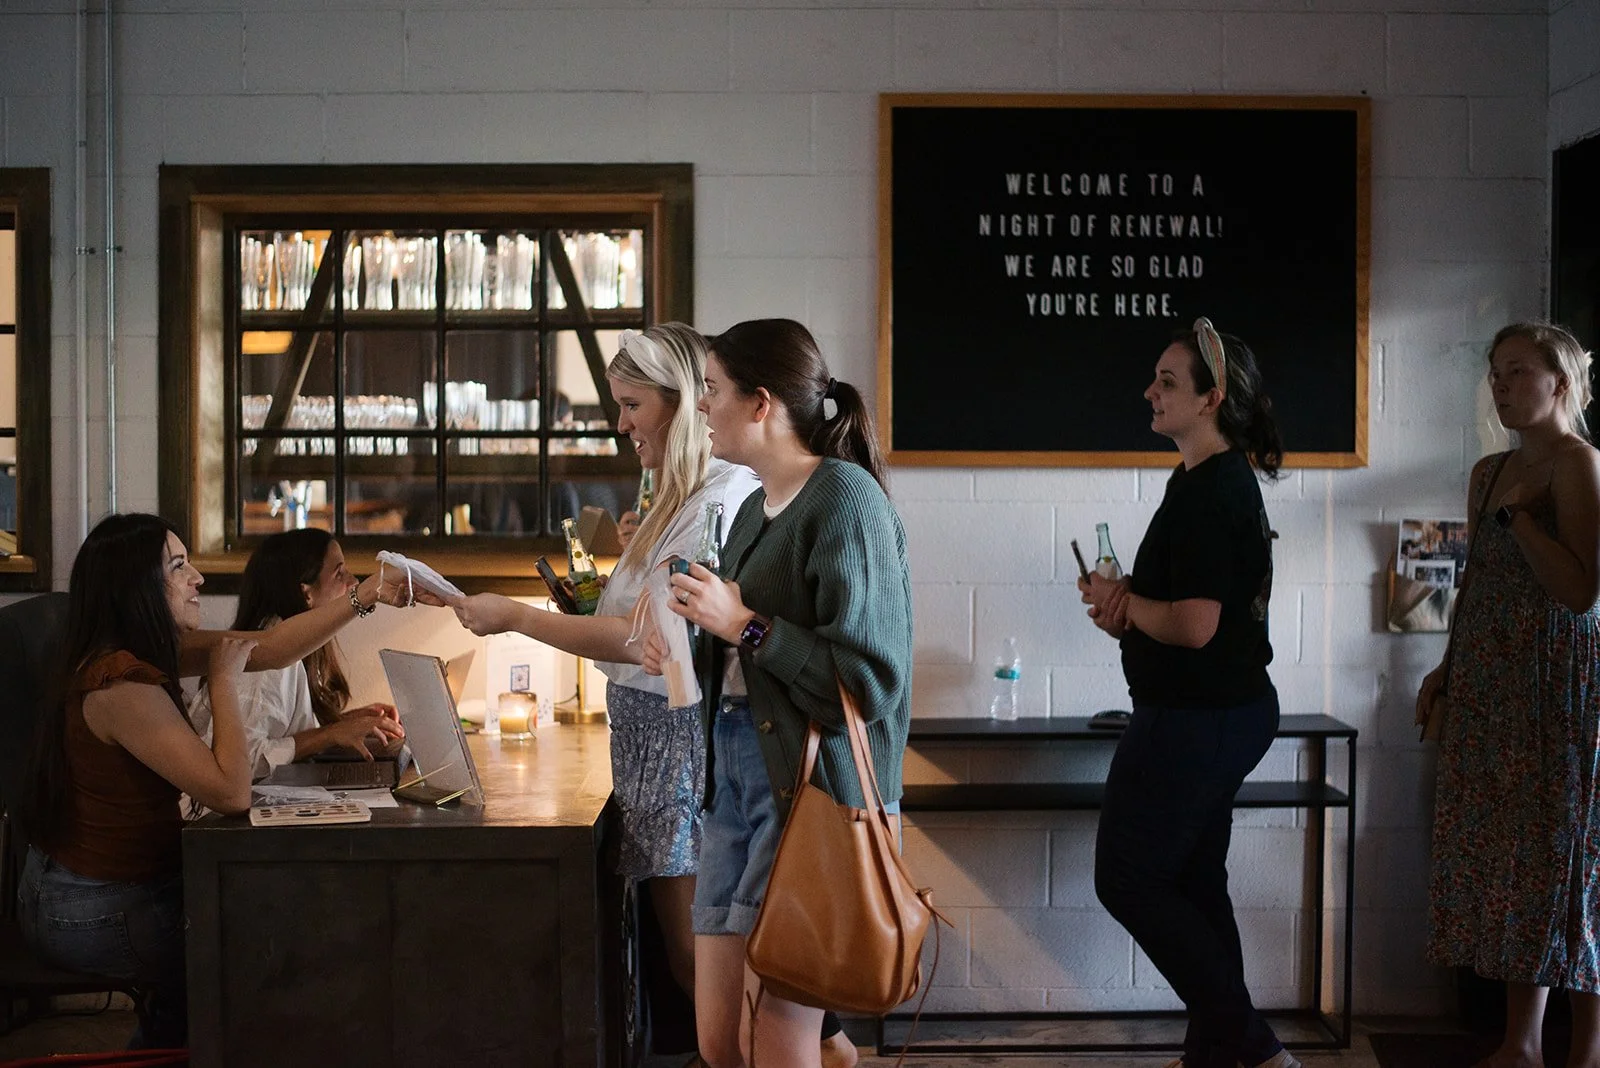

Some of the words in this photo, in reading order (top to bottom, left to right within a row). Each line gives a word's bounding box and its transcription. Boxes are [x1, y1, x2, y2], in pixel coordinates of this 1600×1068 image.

[1006, 173, 1128, 196] WELCOME
[1149, 174, 1173, 196] TO
[1192, 174, 1204, 196] A
[979, 214, 1056, 236] NIGHT
[1070, 214, 1097, 236] OF
[1110, 214, 1223, 237] RENEWAL!
[1005, 255, 1035, 277] WE
[1051, 255, 1091, 277] ARE
[1111, 255, 1135, 277] SO
[1150, 255, 1204, 278] GLAD
[1026, 293, 1099, 316] YOU'RE
[1115, 293, 1178, 316] HERE.
